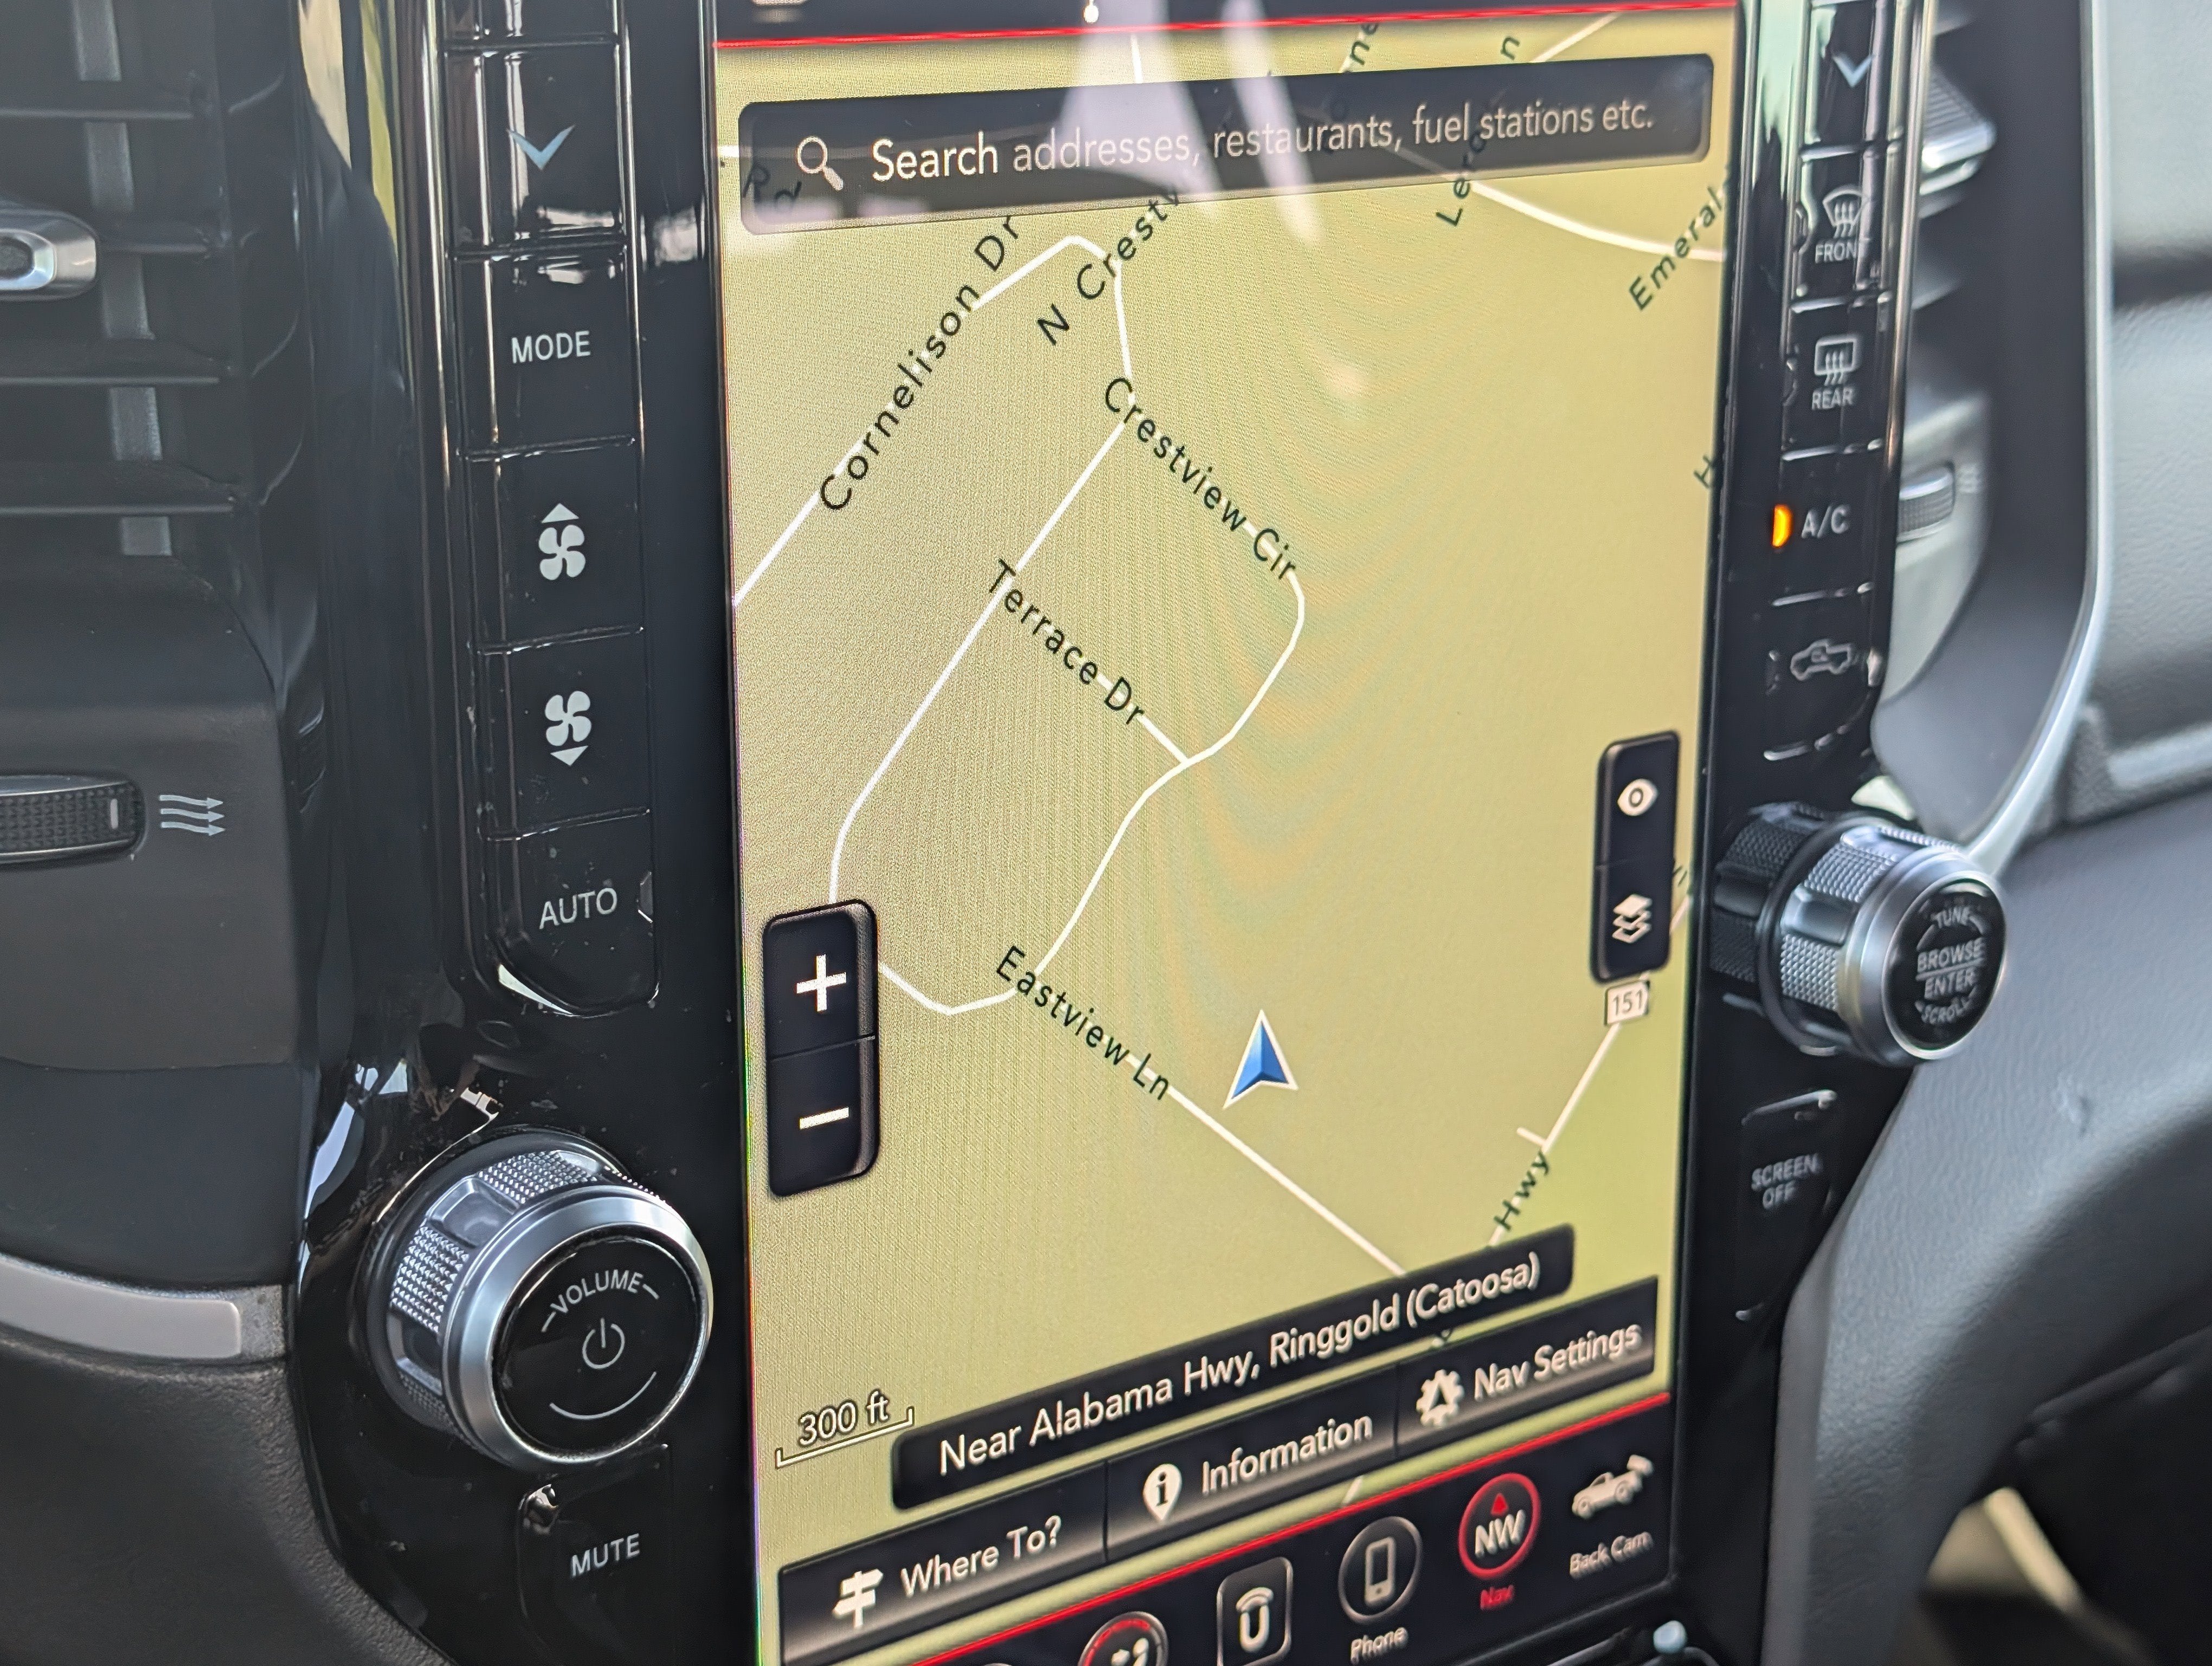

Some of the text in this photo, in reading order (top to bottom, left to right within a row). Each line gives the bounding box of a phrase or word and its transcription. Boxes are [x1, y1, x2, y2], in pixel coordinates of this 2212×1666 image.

[872, 99, 1654, 182] Search addresses, restaurants, fuel stations etc.
[1037, 184, 1180, 345] N Crestv
[1629, 186, 1724, 311] Emeral
[1815, 239, 1861, 264] FRON
[511, 331, 591, 363] MODE
[820, 216, 1021, 510] Cornelison Dr
[1811, 387, 1854, 411] REAR
[1104, 376, 1296, 580] Crestview Cir
[1801, 505, 1850, 539] A/C
[988, 559, 1143, 726] Terrace Dr
[539, 887, 618, 930] AUTO
[1934, 906, 1971, 928] TUNE
[1917, 937, 1984, 973] BROWSE
[1612, 989, 1643, 1016] 151
[1924, 966, 1976, 1000] ENTER
[995, 945, 1169, 1100] Eastview Ln
[1494, 1151, 1550, 1232] Hwy
[1751, 1153, 1821, 1191] SCREEN
[1763, 1181, 1796, 1209] OFF
[551, 1270, 645, 1316] VOLUME
[940, 1251, 1541, 1476] Near Alabama Hwy, Ringgold (Catoosa)
[1474, 1322, 1642, 1401] Nav Settings
[798, 1389, 890, 1448] 300 ft
[1201, 1415, 1373, 1496] Information
[571, 1533, 641, 1578] MUTE
[900, 1515, 1062, 1598] Where To?
[1475, 1509, 1526, 1559] NW
[1570, 1532, 1654, 1579] Back Cam
[1480, 1584, 1515, 1611] Nav
[1350, 1626, 1409, 1665] Phone
